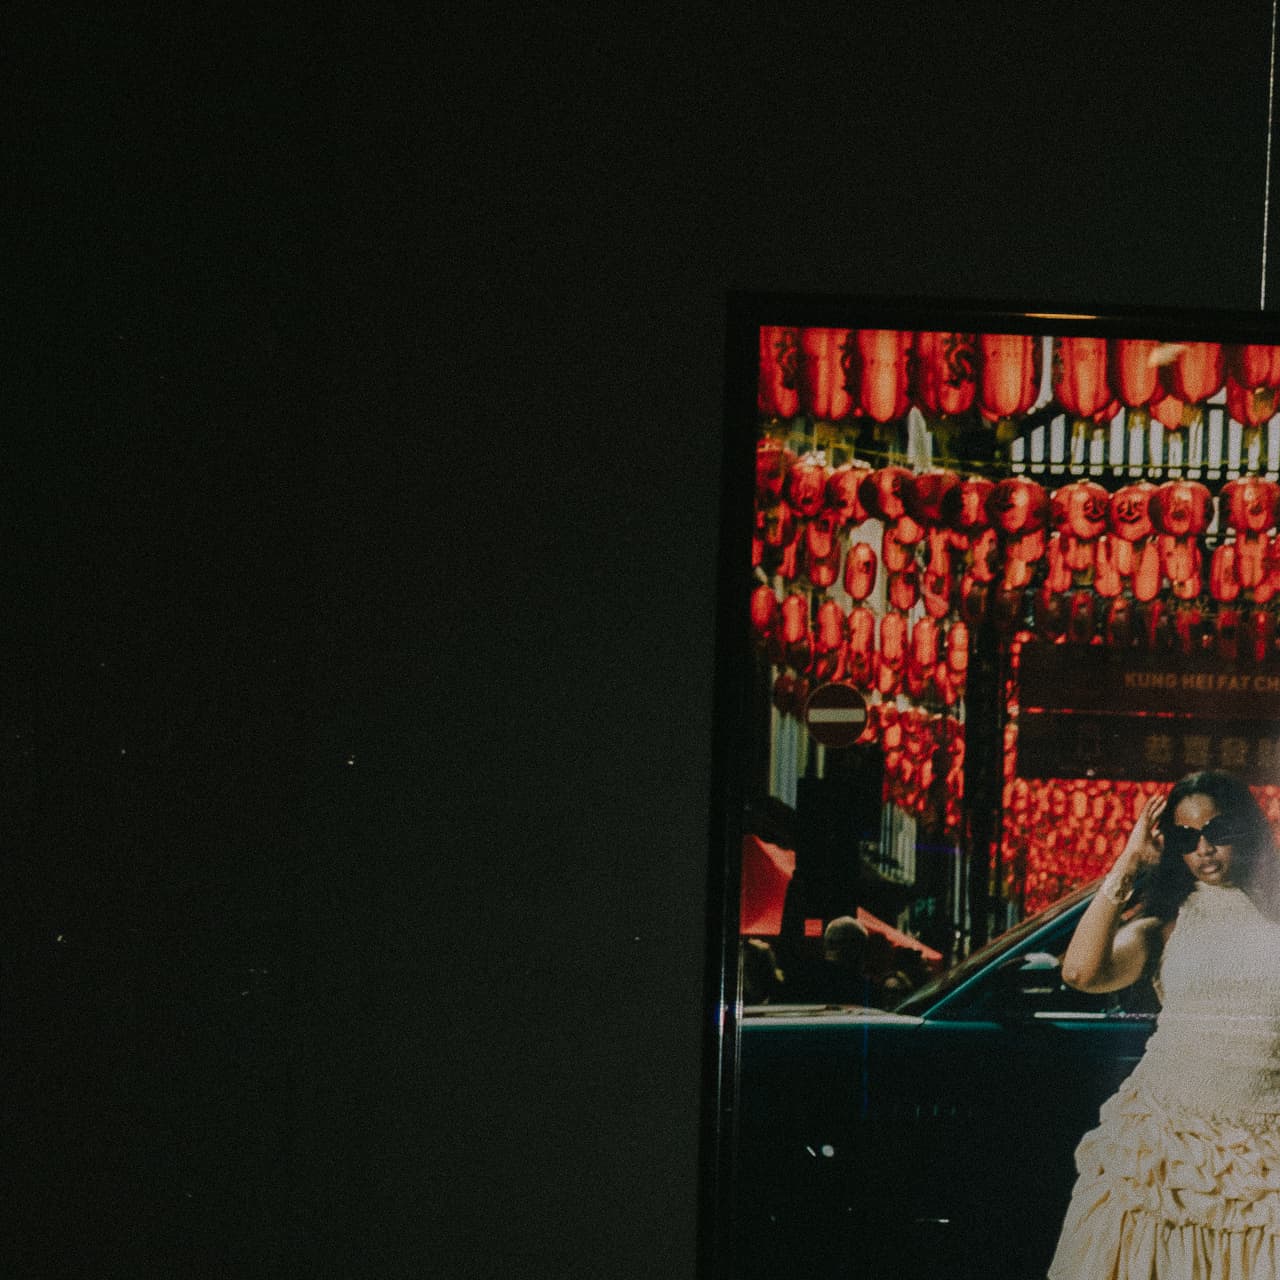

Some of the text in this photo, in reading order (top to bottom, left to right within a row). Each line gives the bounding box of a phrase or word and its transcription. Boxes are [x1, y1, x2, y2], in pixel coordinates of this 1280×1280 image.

[1124, 672, 1177, 688] KUNG
[1181, 673, 1214, 690] HEI
[1216, 674, 1250, 691] FAT
